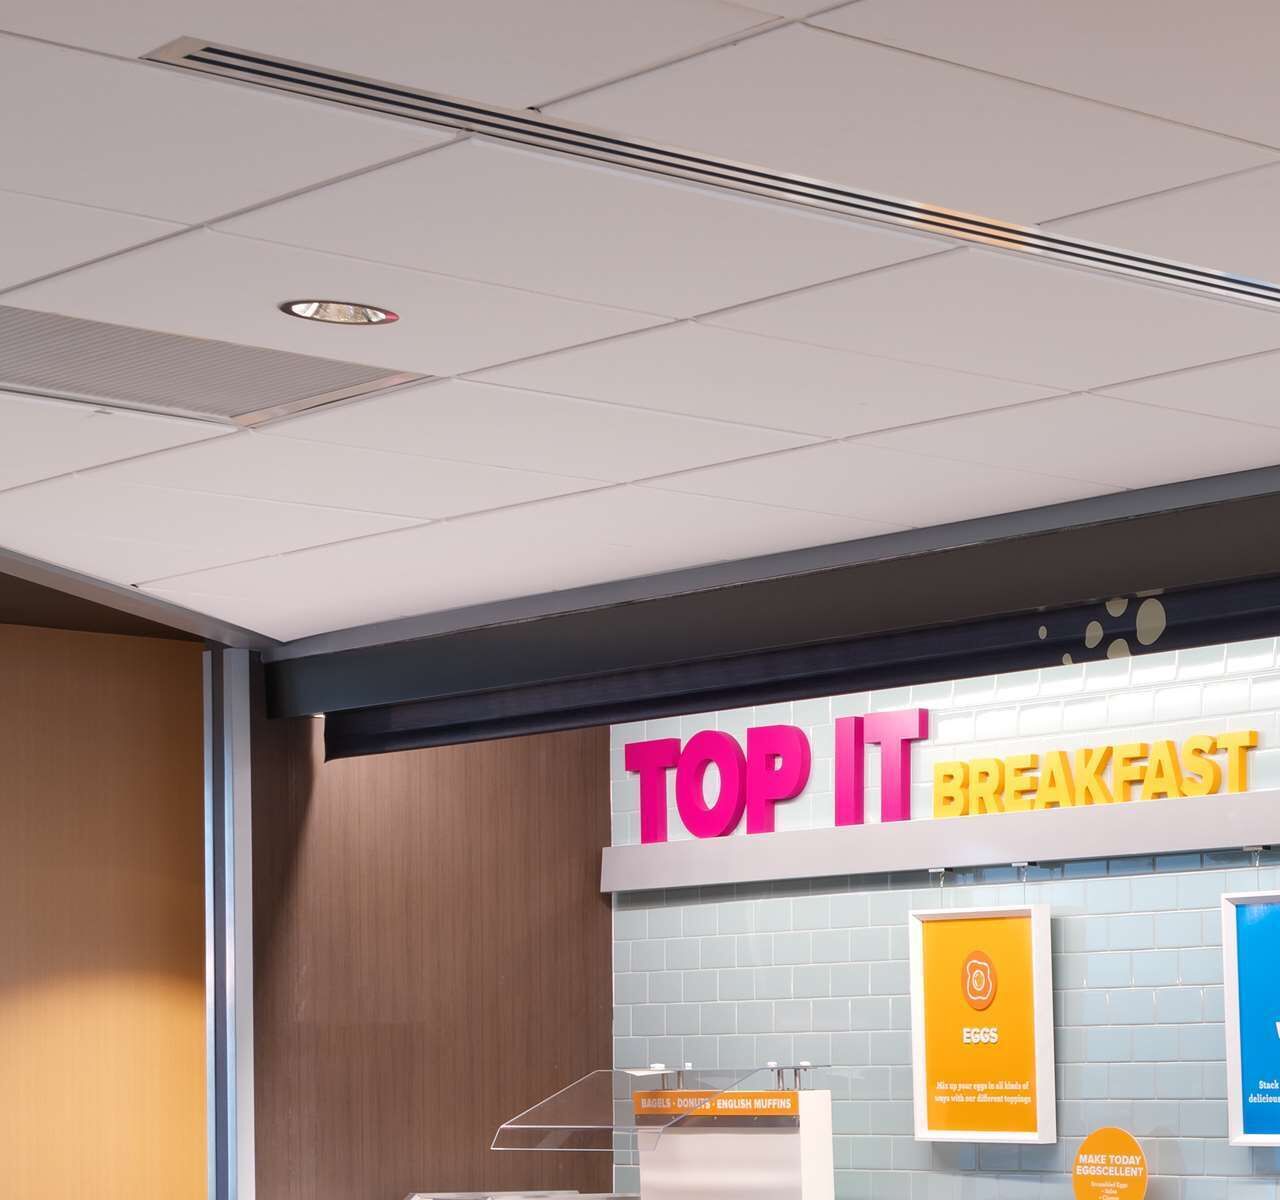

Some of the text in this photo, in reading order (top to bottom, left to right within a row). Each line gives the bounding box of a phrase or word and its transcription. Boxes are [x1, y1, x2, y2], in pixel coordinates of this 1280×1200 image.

[625, 708, 928, 844] TOP IT
[934, 731, 1259, 818] BREAKFAST
[963, 1027, 998, 1044] EGGS
[1258, 1079, 1279, 1090] Stack
[641, 1098, 792, 1109] BAGELS DONUTS ENGLISH MUFFINS
[1248, 1093, 1280, 1104] delicious
[1079, 1154, 1142, 1166] MAKE TODAY
[1076, 1165, 1144, 1177] EGGSCELLENT
